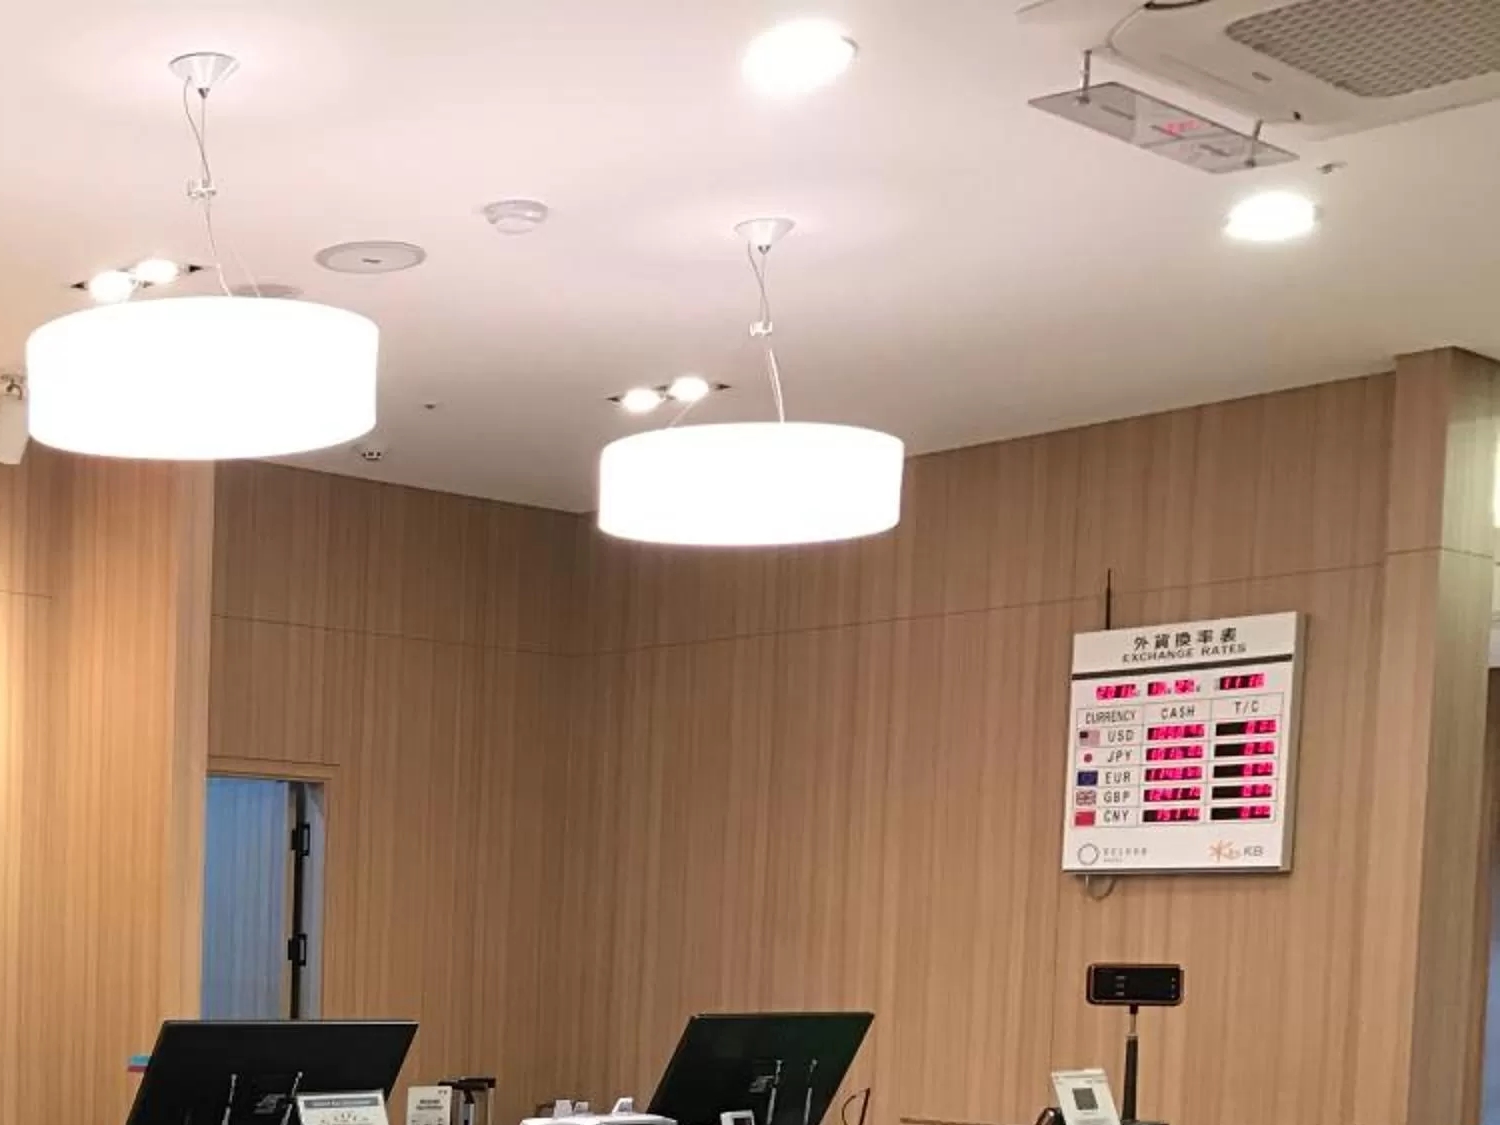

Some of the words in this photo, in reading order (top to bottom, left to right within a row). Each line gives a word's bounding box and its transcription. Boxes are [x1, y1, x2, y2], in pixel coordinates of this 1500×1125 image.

[1122, 648, 1194, 663] EXCHANGE
[1201, 643, 1247, 656] RATES
[1161, 706, 1195, 720] CASH
[1234, 700, 1260, 715] T/C
[1085, 710, 1137, 725] CURRENCY
[1107, 729, 1135, 743] USD
[1107, 750, 1133, 763] JPY
[1105, 771, 1131, 785] EUR
[1103, 790, 1131, 804] GBP
[1103, 810, 1130, 824] CNY
[1243, 845, 1263, 857] KB
